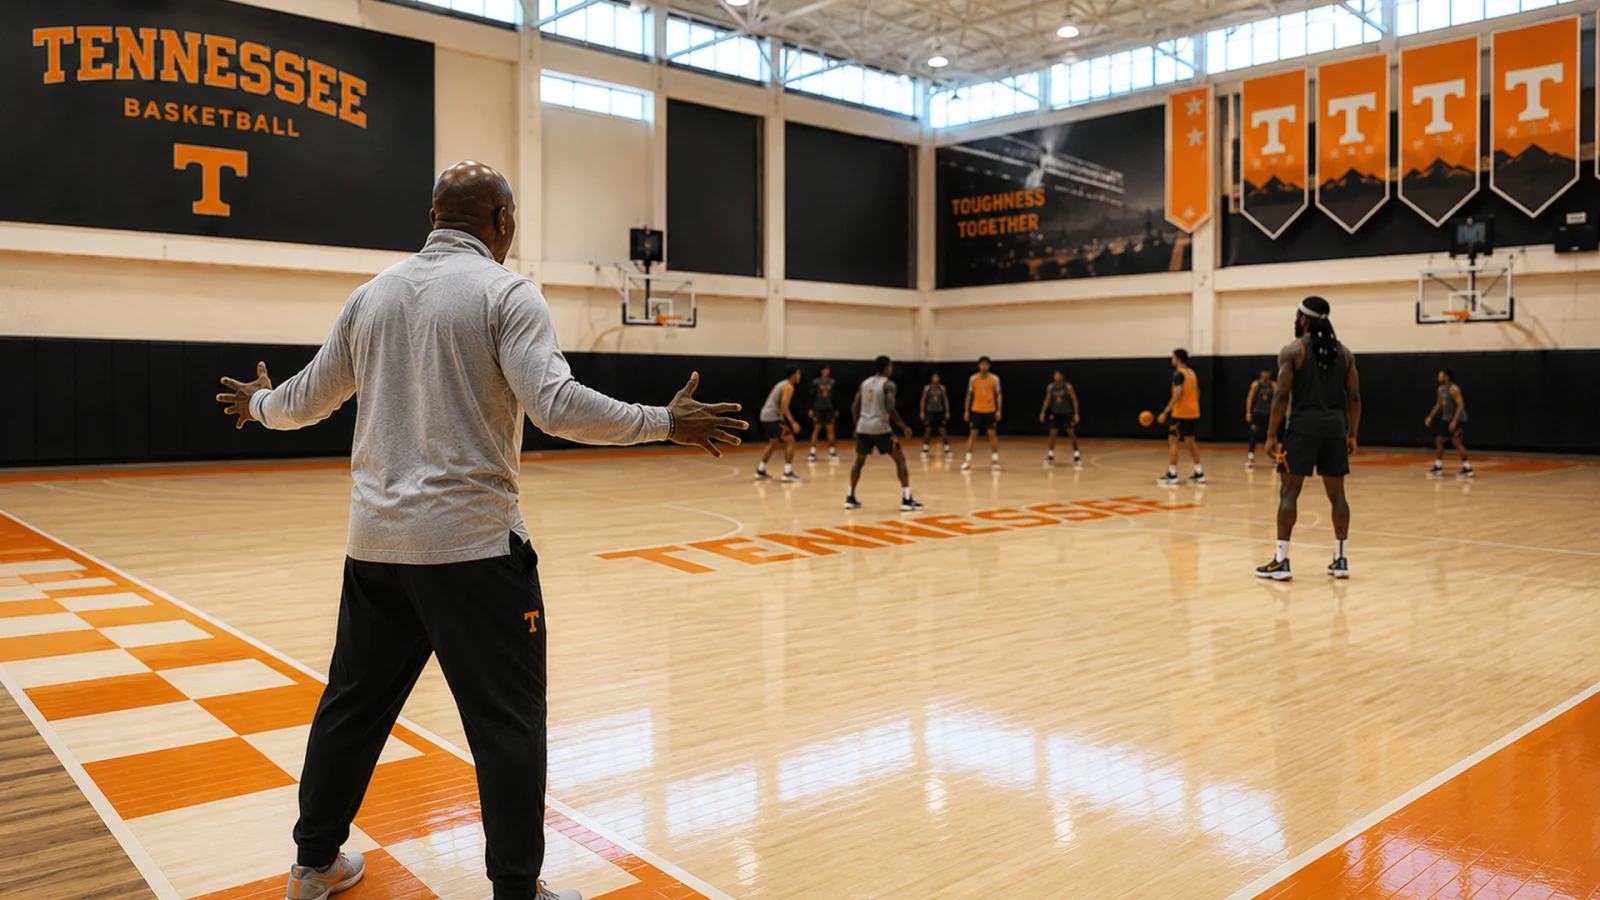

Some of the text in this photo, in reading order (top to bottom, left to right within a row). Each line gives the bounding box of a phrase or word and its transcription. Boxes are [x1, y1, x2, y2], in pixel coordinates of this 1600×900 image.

[33, 26, 367, 128] TENNESSEE
[1505, 63, 1563, 121] T
[124, 98, 300, 137] BASKETBALL
[1251, 105, 1296, 155] T
[1328, 93, 1376, 144] T
[1412, 79, 1465, 134] T
[173, 143, 248, 216] T
[952, 188, 1046, 216] TOUGHNESS
[958, 212, 1039, 238] TOGETHER
[595, 496, 1201, 574] TENNESSEE
[524, 610, 539, 633] T
